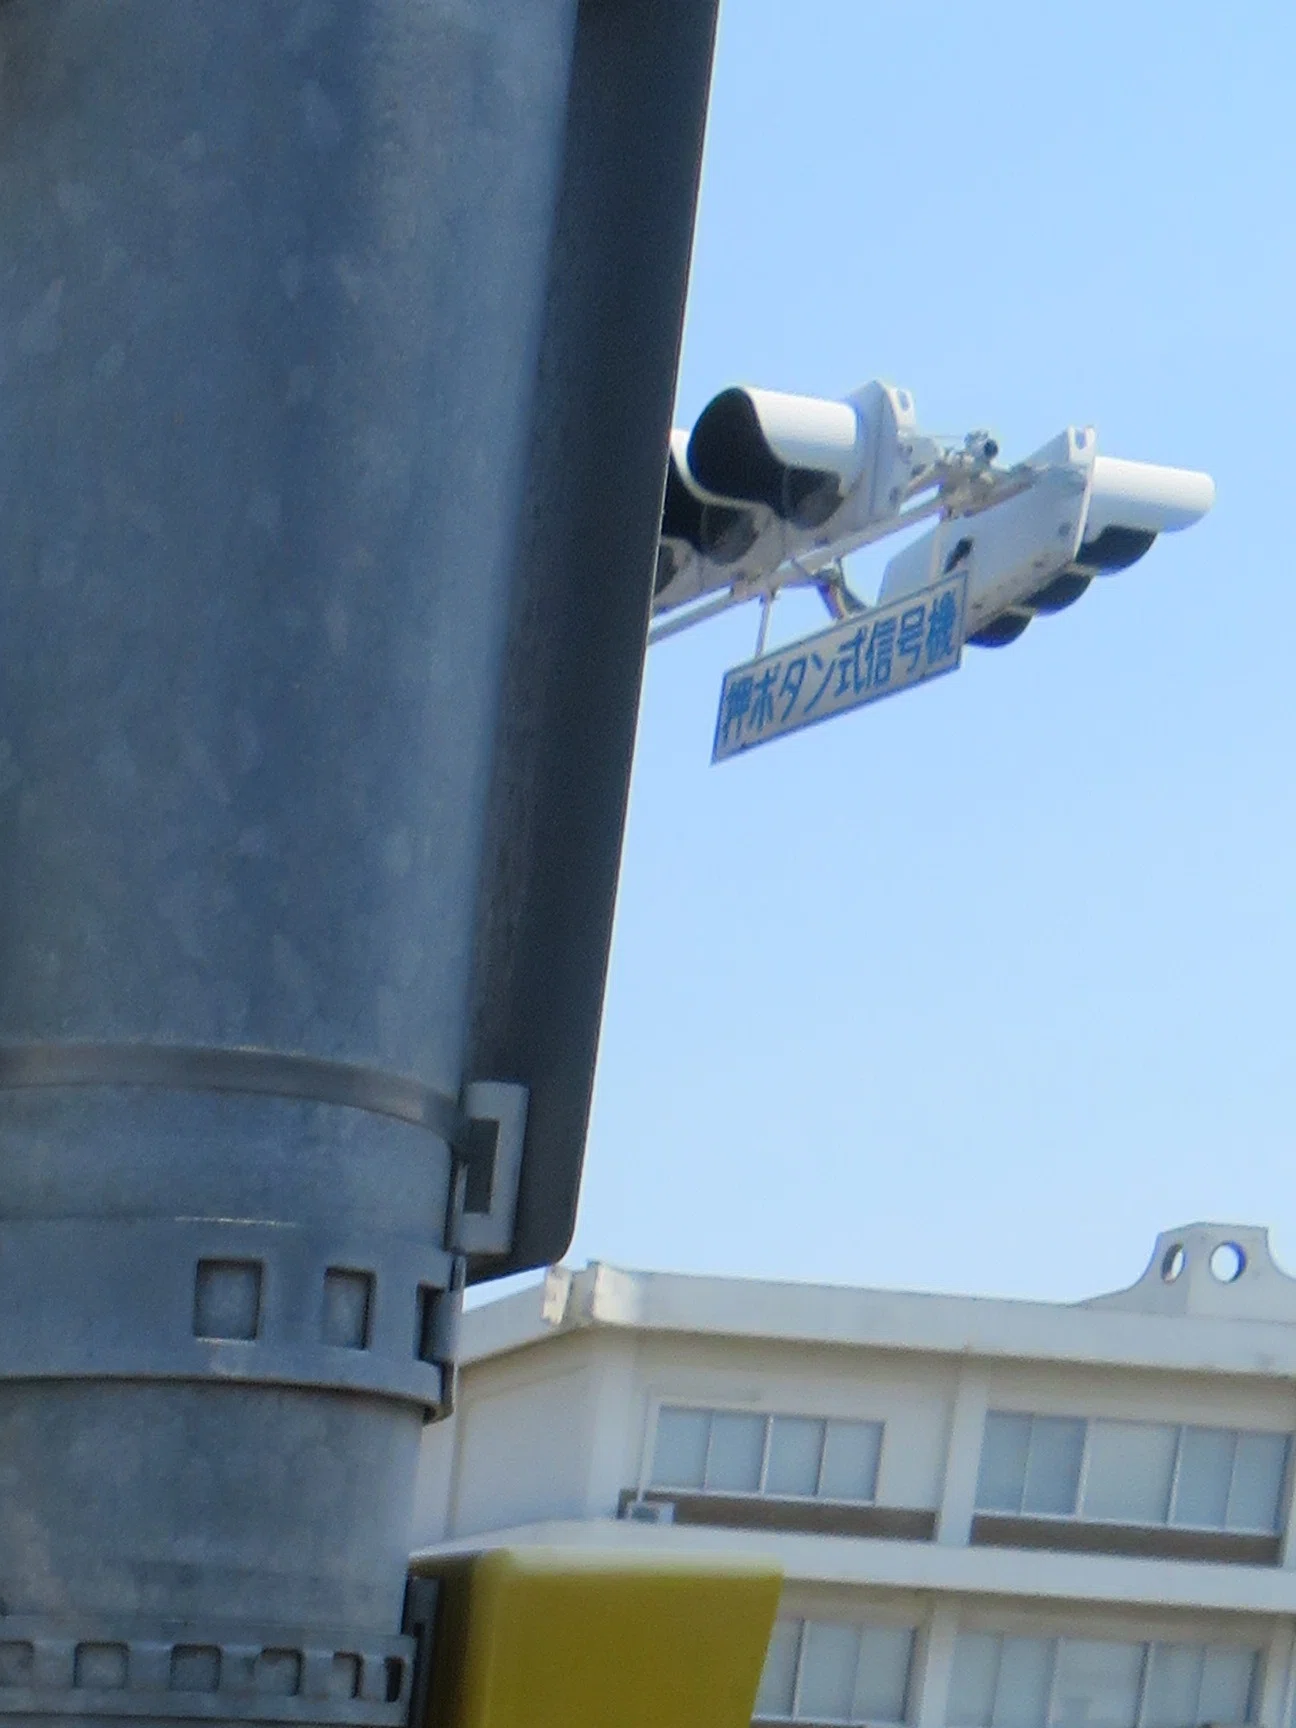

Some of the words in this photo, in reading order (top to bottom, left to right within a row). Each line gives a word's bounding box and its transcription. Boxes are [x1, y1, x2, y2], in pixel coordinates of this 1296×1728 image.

[722, 589, 957, 748] 押ボタン式信号機
